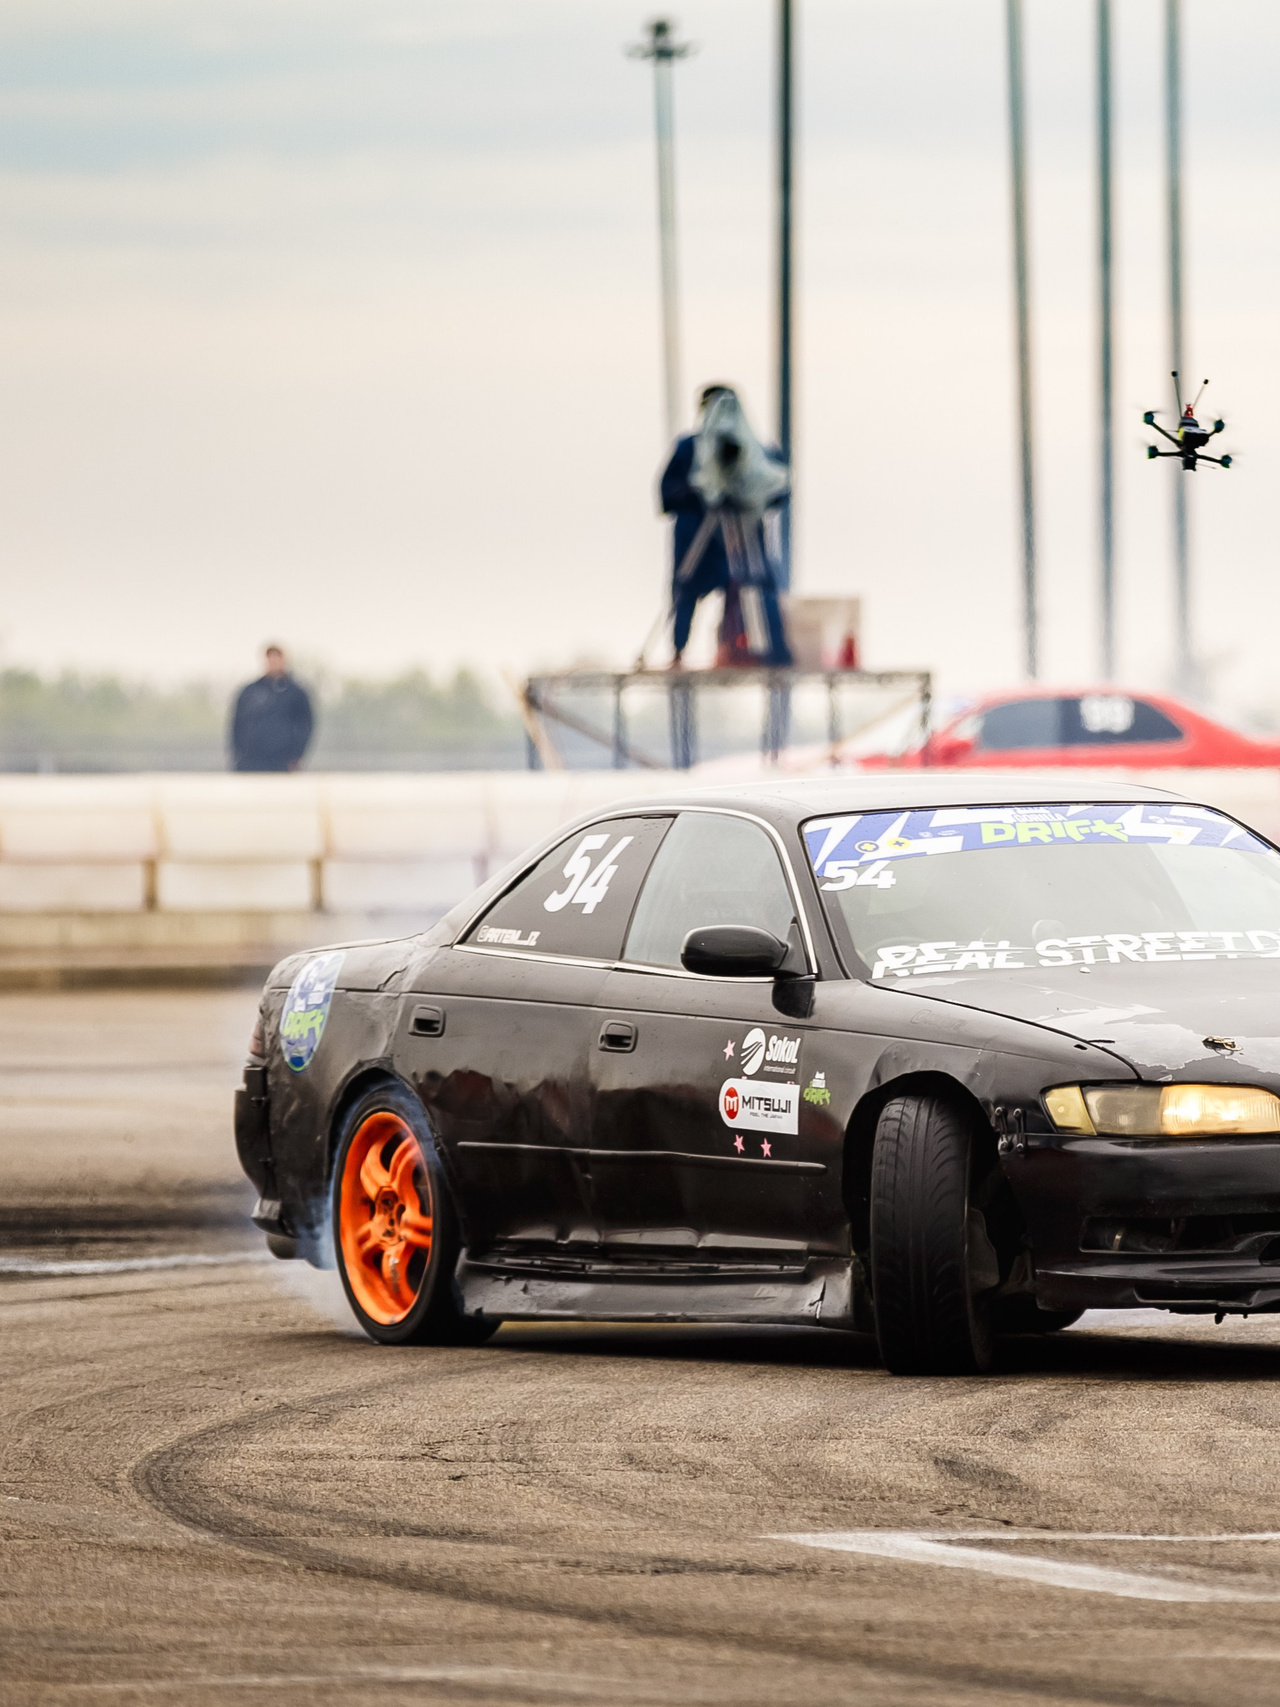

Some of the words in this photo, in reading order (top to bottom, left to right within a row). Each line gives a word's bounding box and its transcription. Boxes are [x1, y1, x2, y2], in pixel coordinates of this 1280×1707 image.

[980, 819, 1129, 844] DRIFT
[543, 833, 634, 914] 54
[820, 860, 896, 891] 54
[872, 940, 1036, 979] REAL
[741, 1095, 791, 1114] MITSUJI
